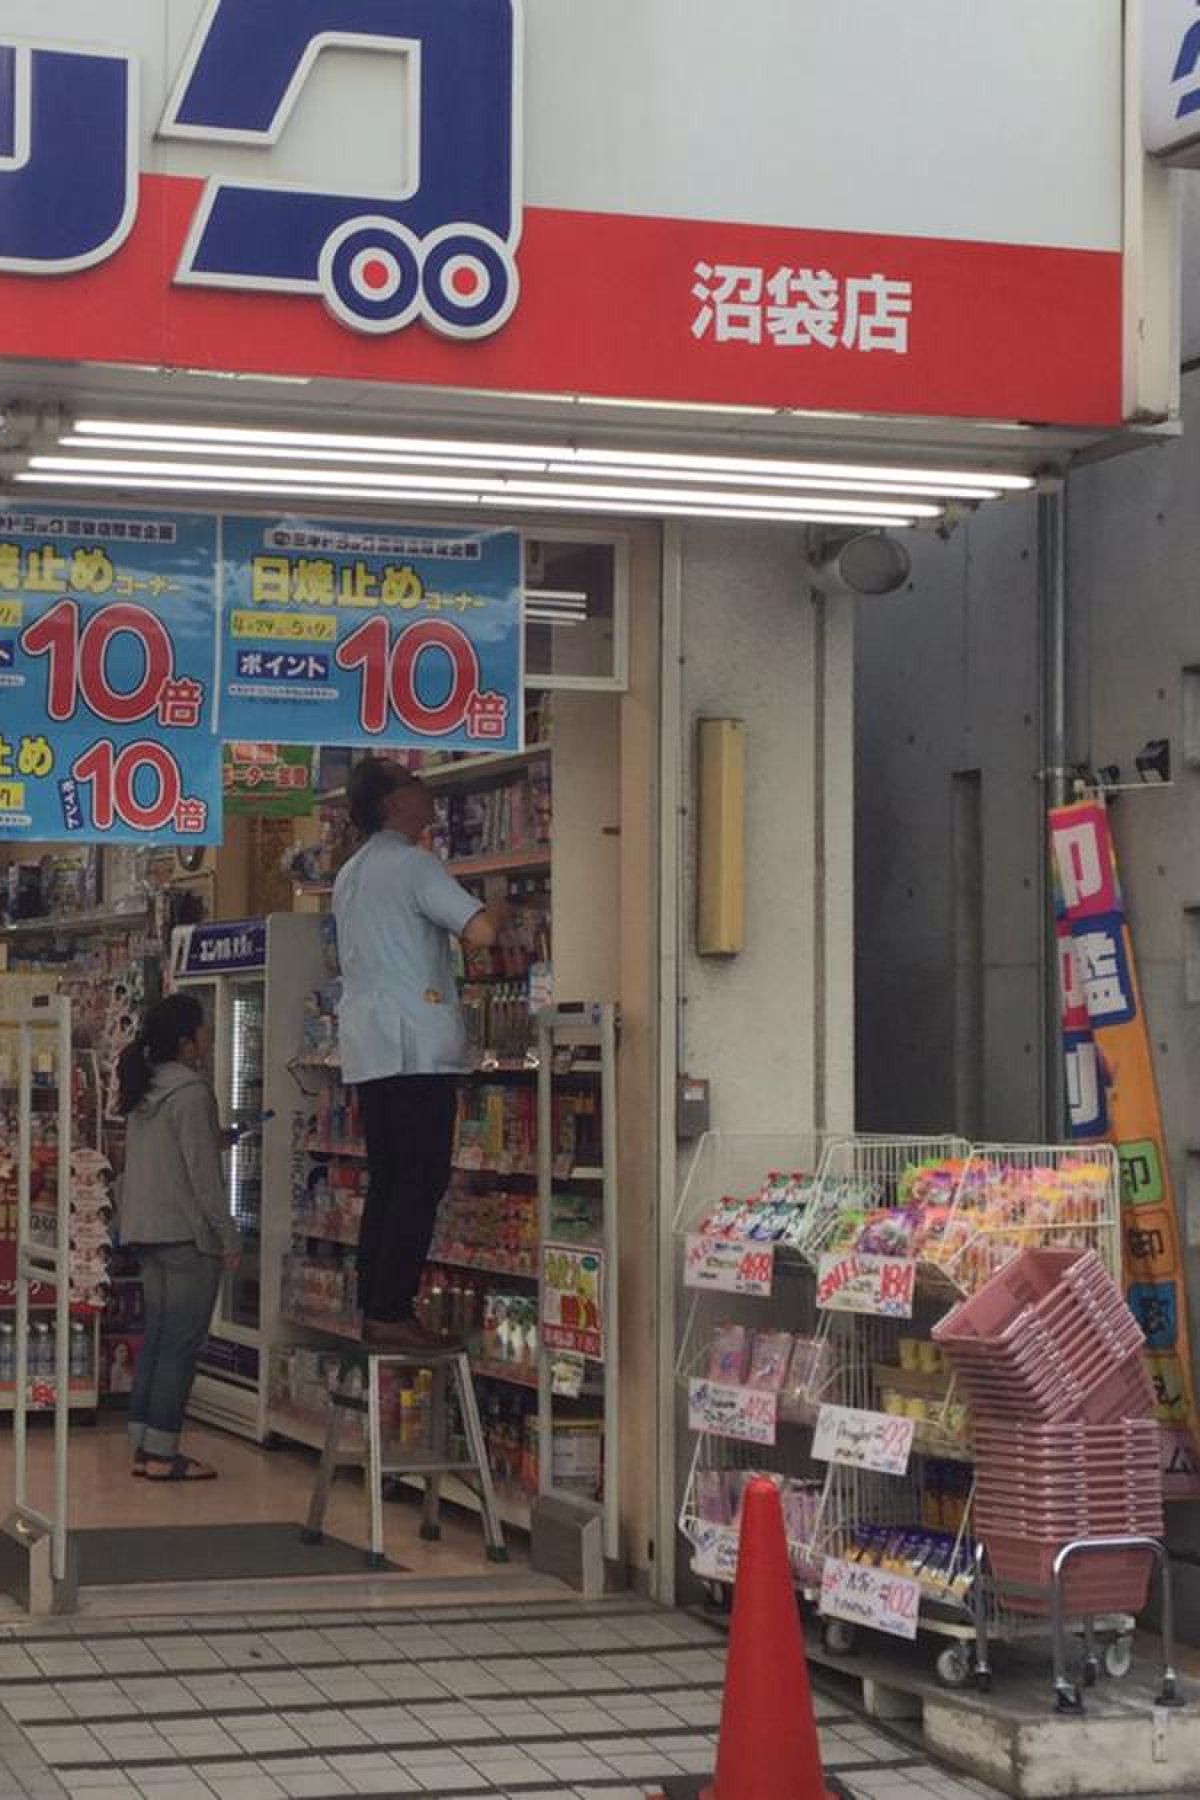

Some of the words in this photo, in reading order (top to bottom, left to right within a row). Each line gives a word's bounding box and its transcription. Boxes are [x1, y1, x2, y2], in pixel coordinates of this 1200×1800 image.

[689, 261, 913, 354] 沼袋店
[238, 653, 326, 678] ポイント
[61, 779, 84, 831] ポイント
